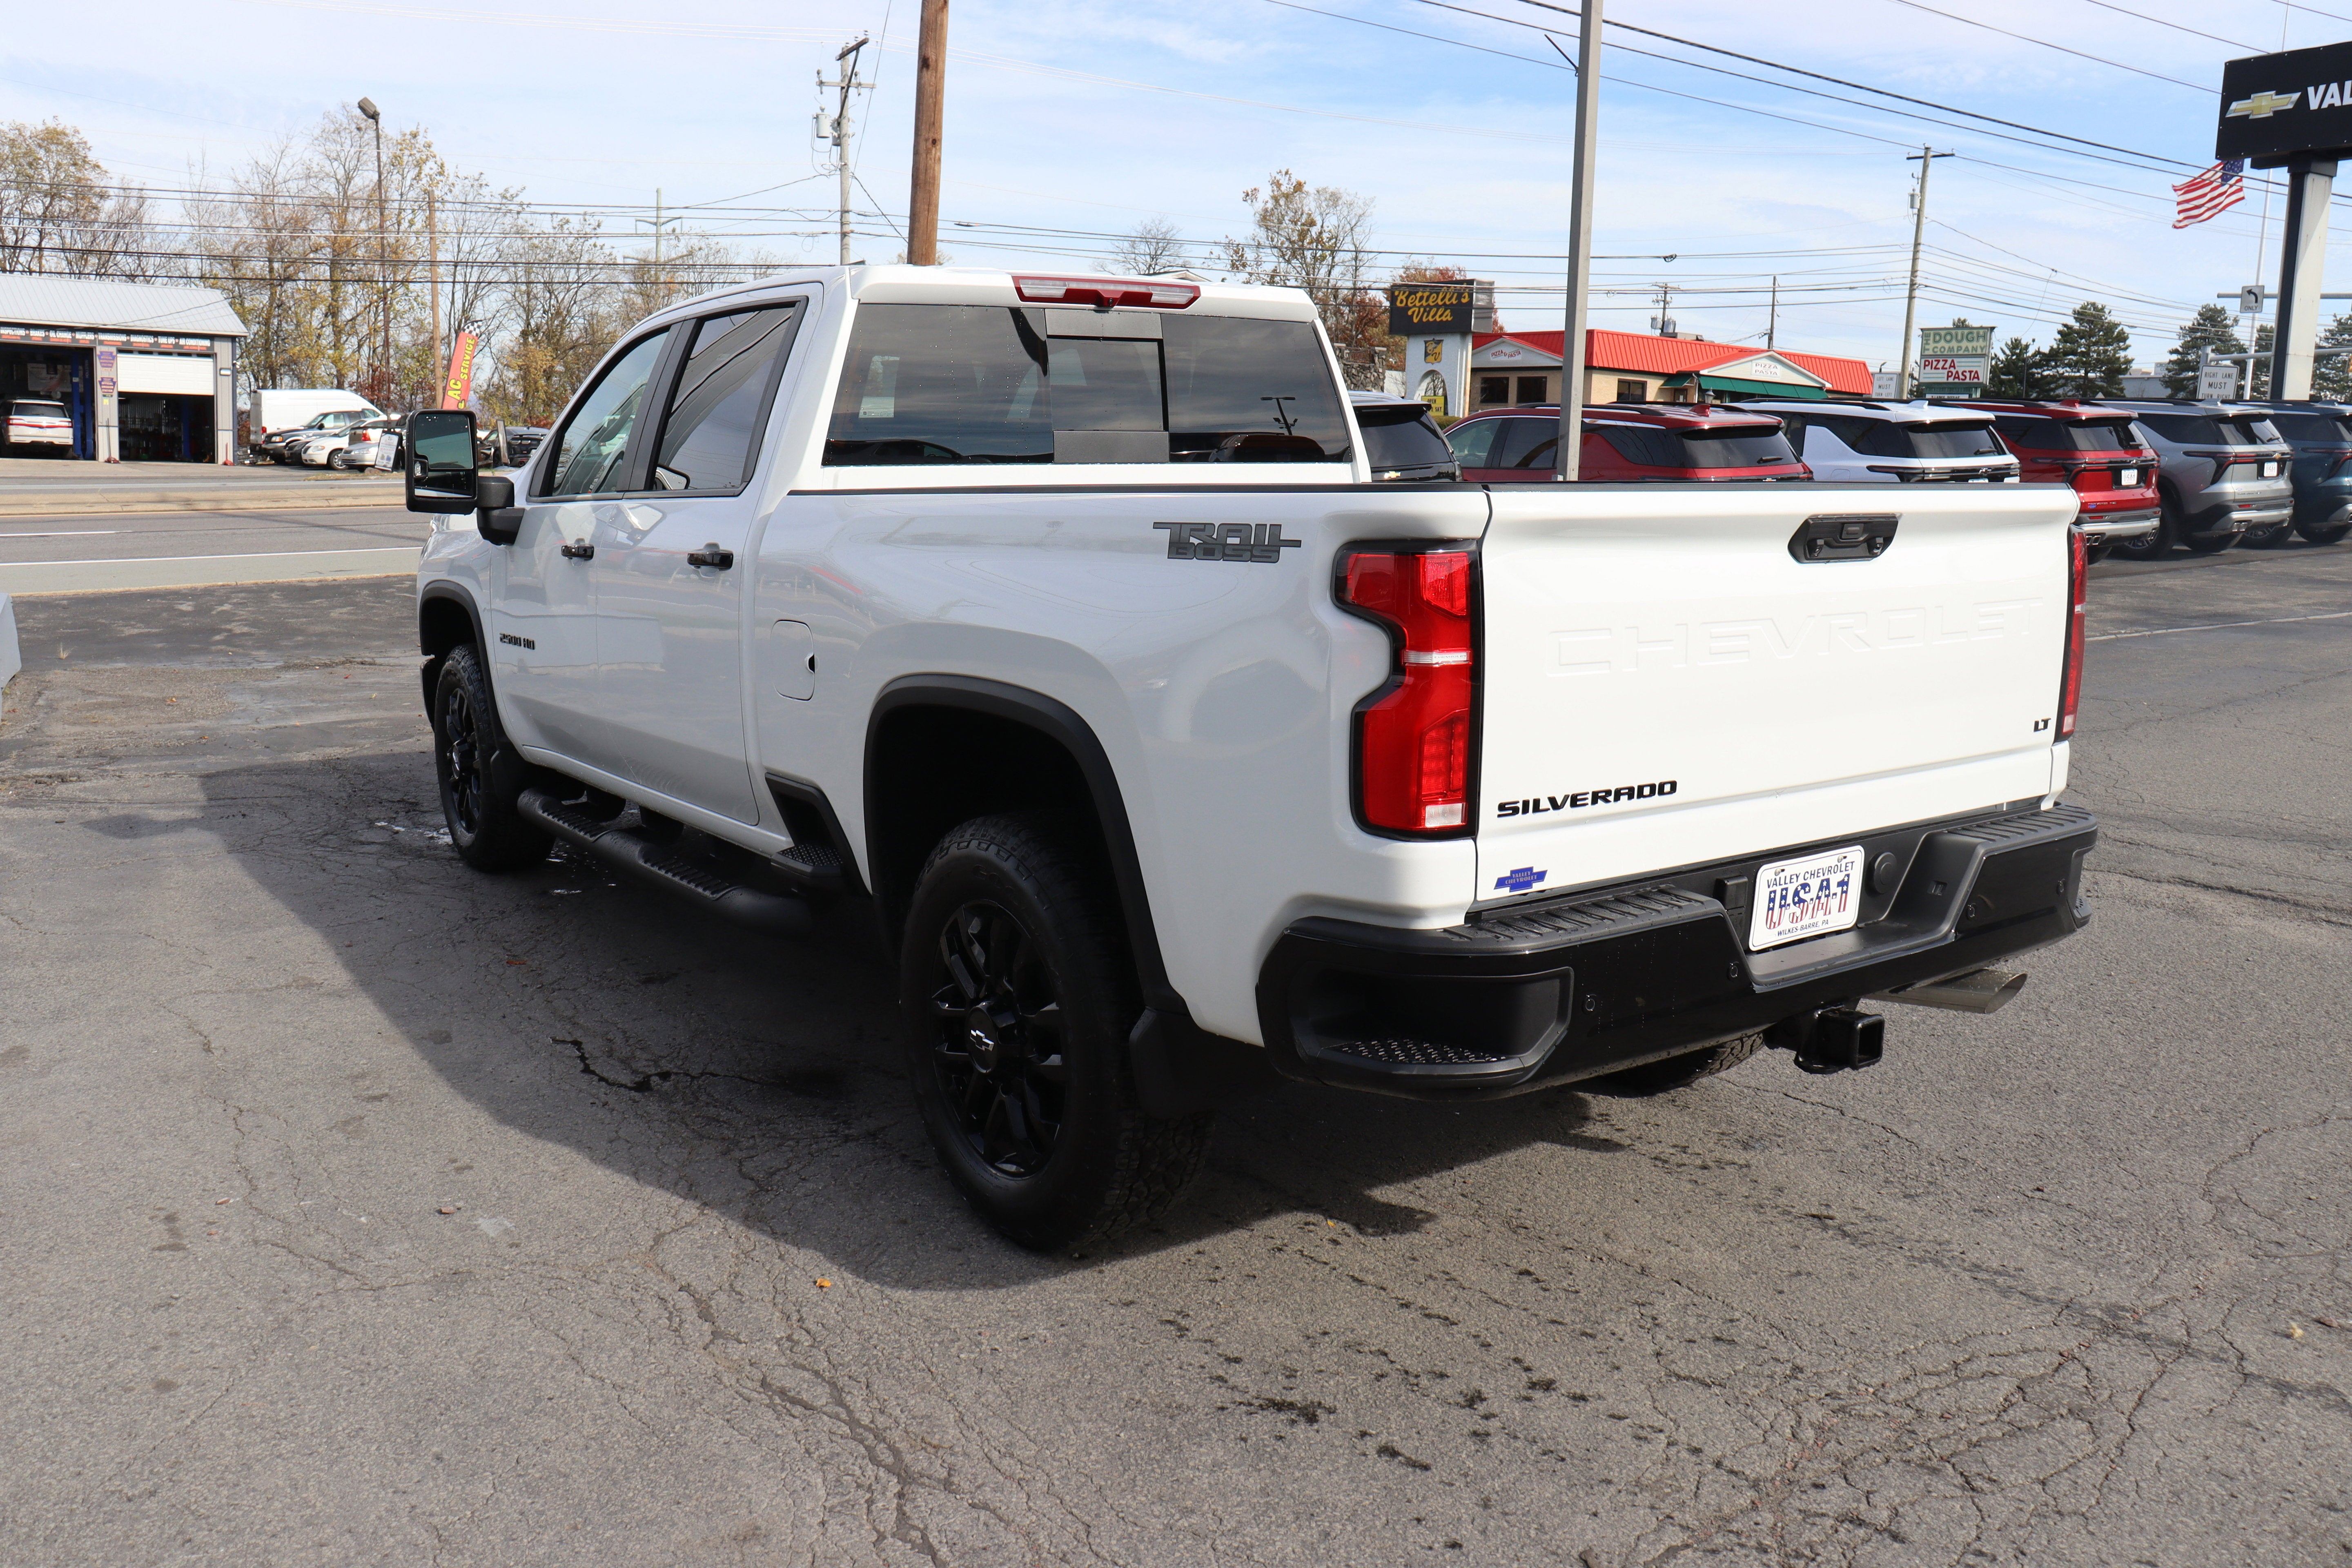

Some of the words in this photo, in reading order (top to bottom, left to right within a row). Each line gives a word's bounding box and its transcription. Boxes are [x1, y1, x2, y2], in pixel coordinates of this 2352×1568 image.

[1394, 283, 1470, 306] Bettelli's
[1408, 306, 1453, 323] Villa
[1933, 330, 1988, 344] DOUGH
[1508, 350, 1521, 359] PASTA
[1932, 345, 1986, 354] COMPANY
[447, 379, 462, 401] AC
[460, 336, 476, 381] SERVICE
[1924, 359, 1956, 370] PIZZA
[1947, 370, 1980, 381] PASTA
[1153, 522, 1302, 548] TRAIL
[1167, 542, 1281, 564] BOSS
[499, 632, 521, 647] 2500
[523, 638, 535, 650] HD
[1546, 597, 2043, 678] CHEVROLET
[2034, 717, 2051, 733] LT
[1497, 780, 1677, 818] SILVERADO
[1505, 875, 1537, 884] CHEVROLET
[1767, 873, 1801, 889] VALLEY
[1803, 861, 1855, 881] CHEVROLET
[1777, 922, 1820, 936] WILKES-BARRE,
